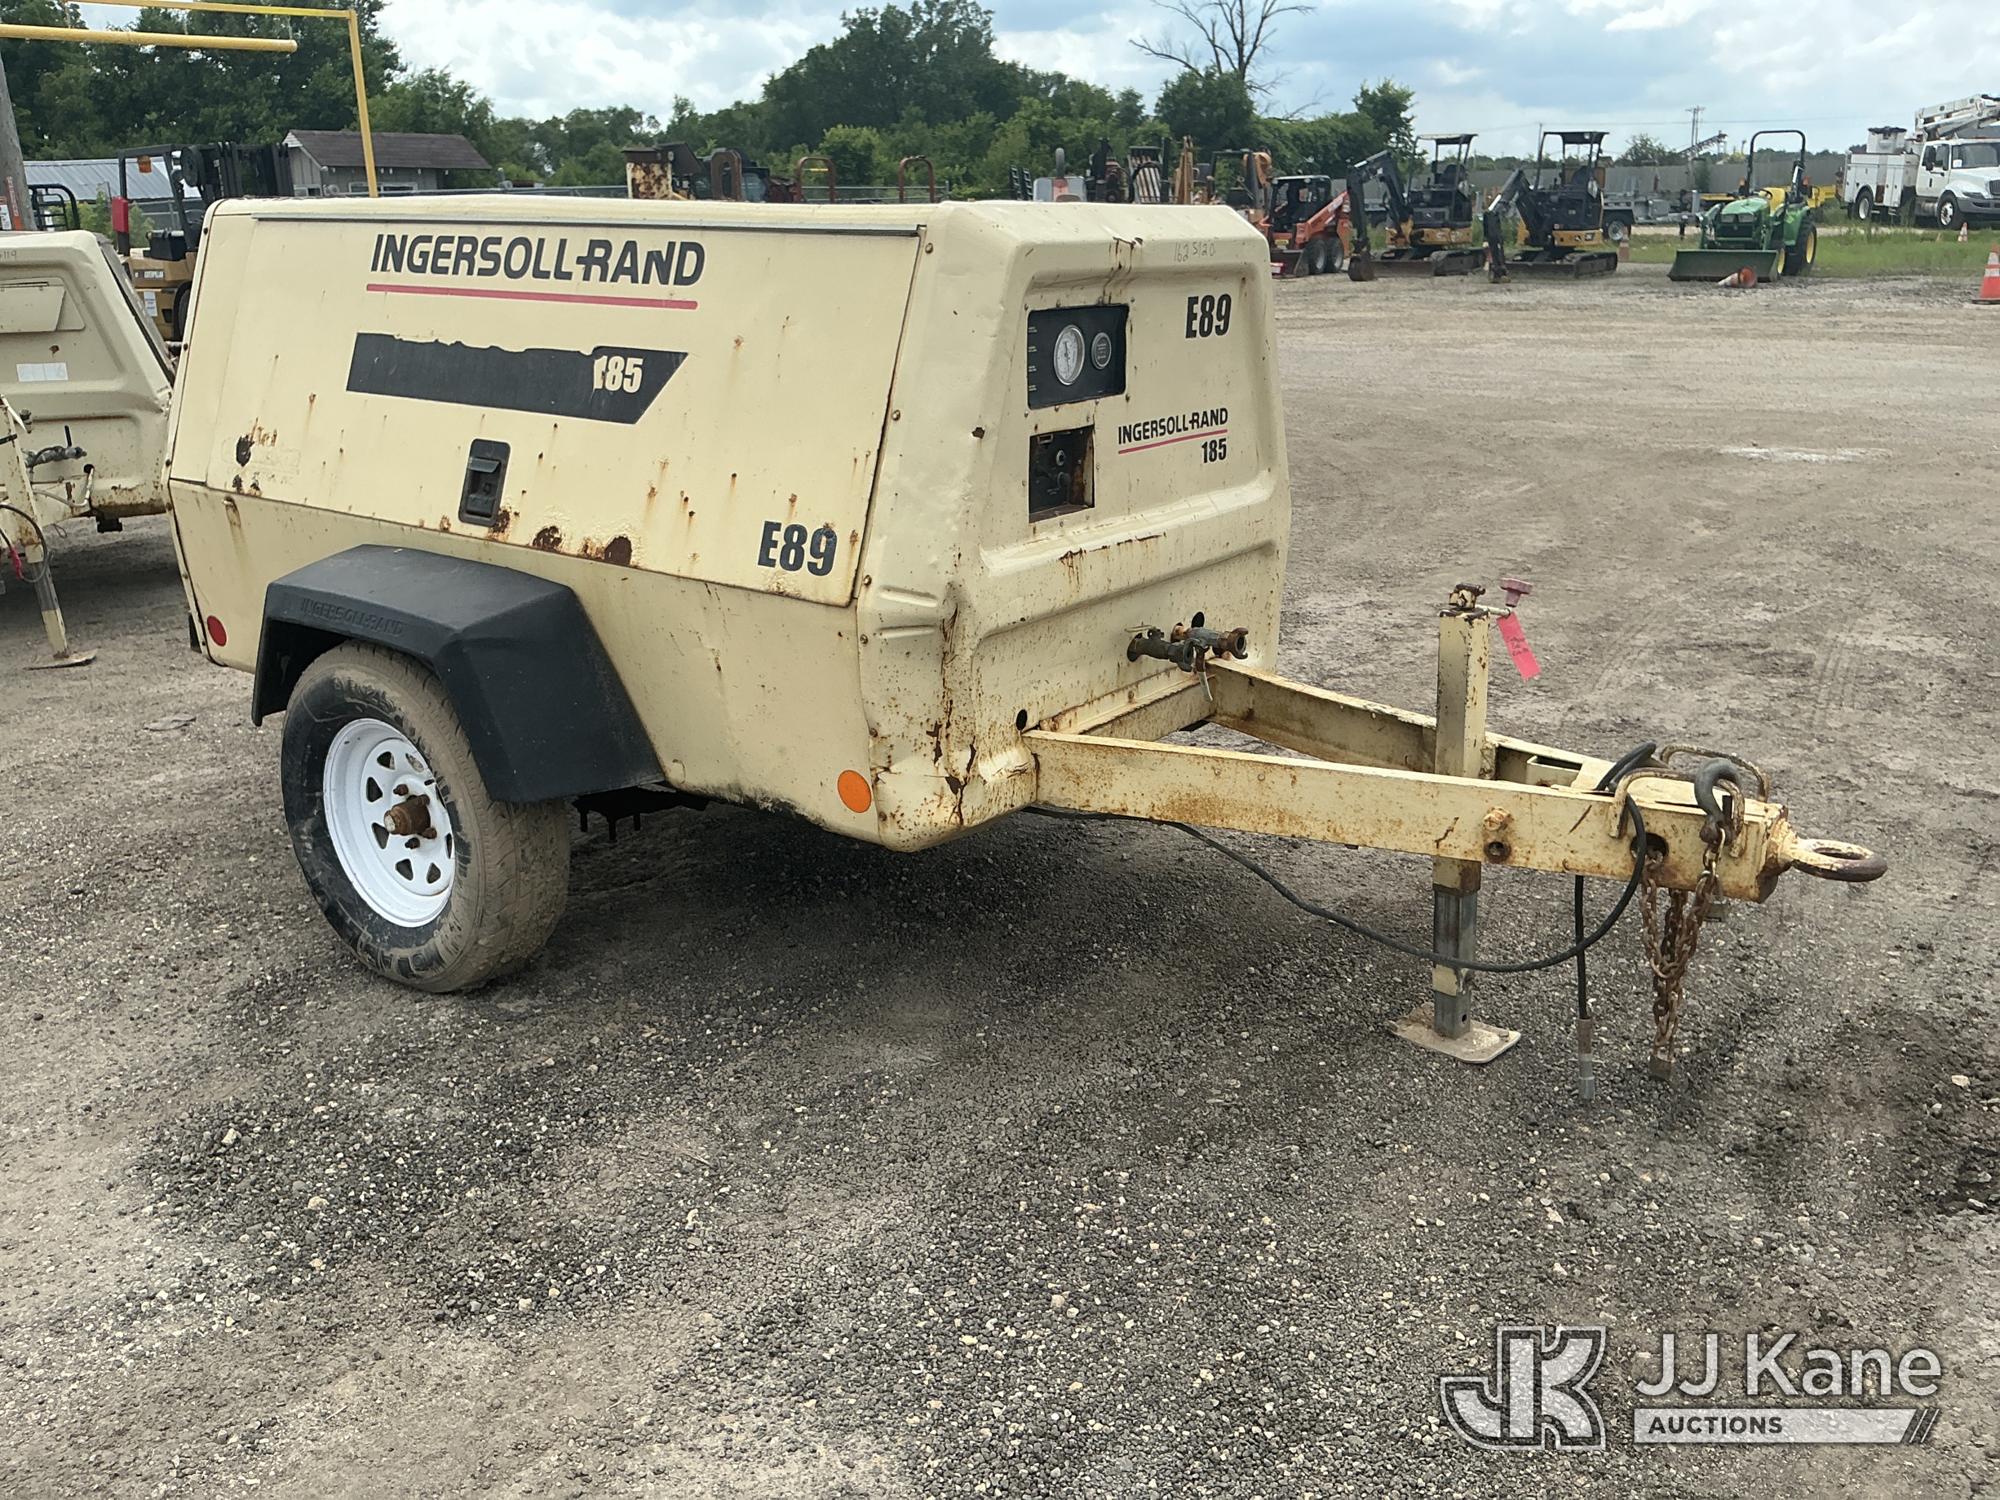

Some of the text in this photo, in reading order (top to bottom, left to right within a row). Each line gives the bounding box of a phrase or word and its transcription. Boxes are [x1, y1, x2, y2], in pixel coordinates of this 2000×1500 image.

[1185, 293, 1232, 339] E89
[1201, 437, 1227, 463] 185
[757, 520, 837, 576] E89
